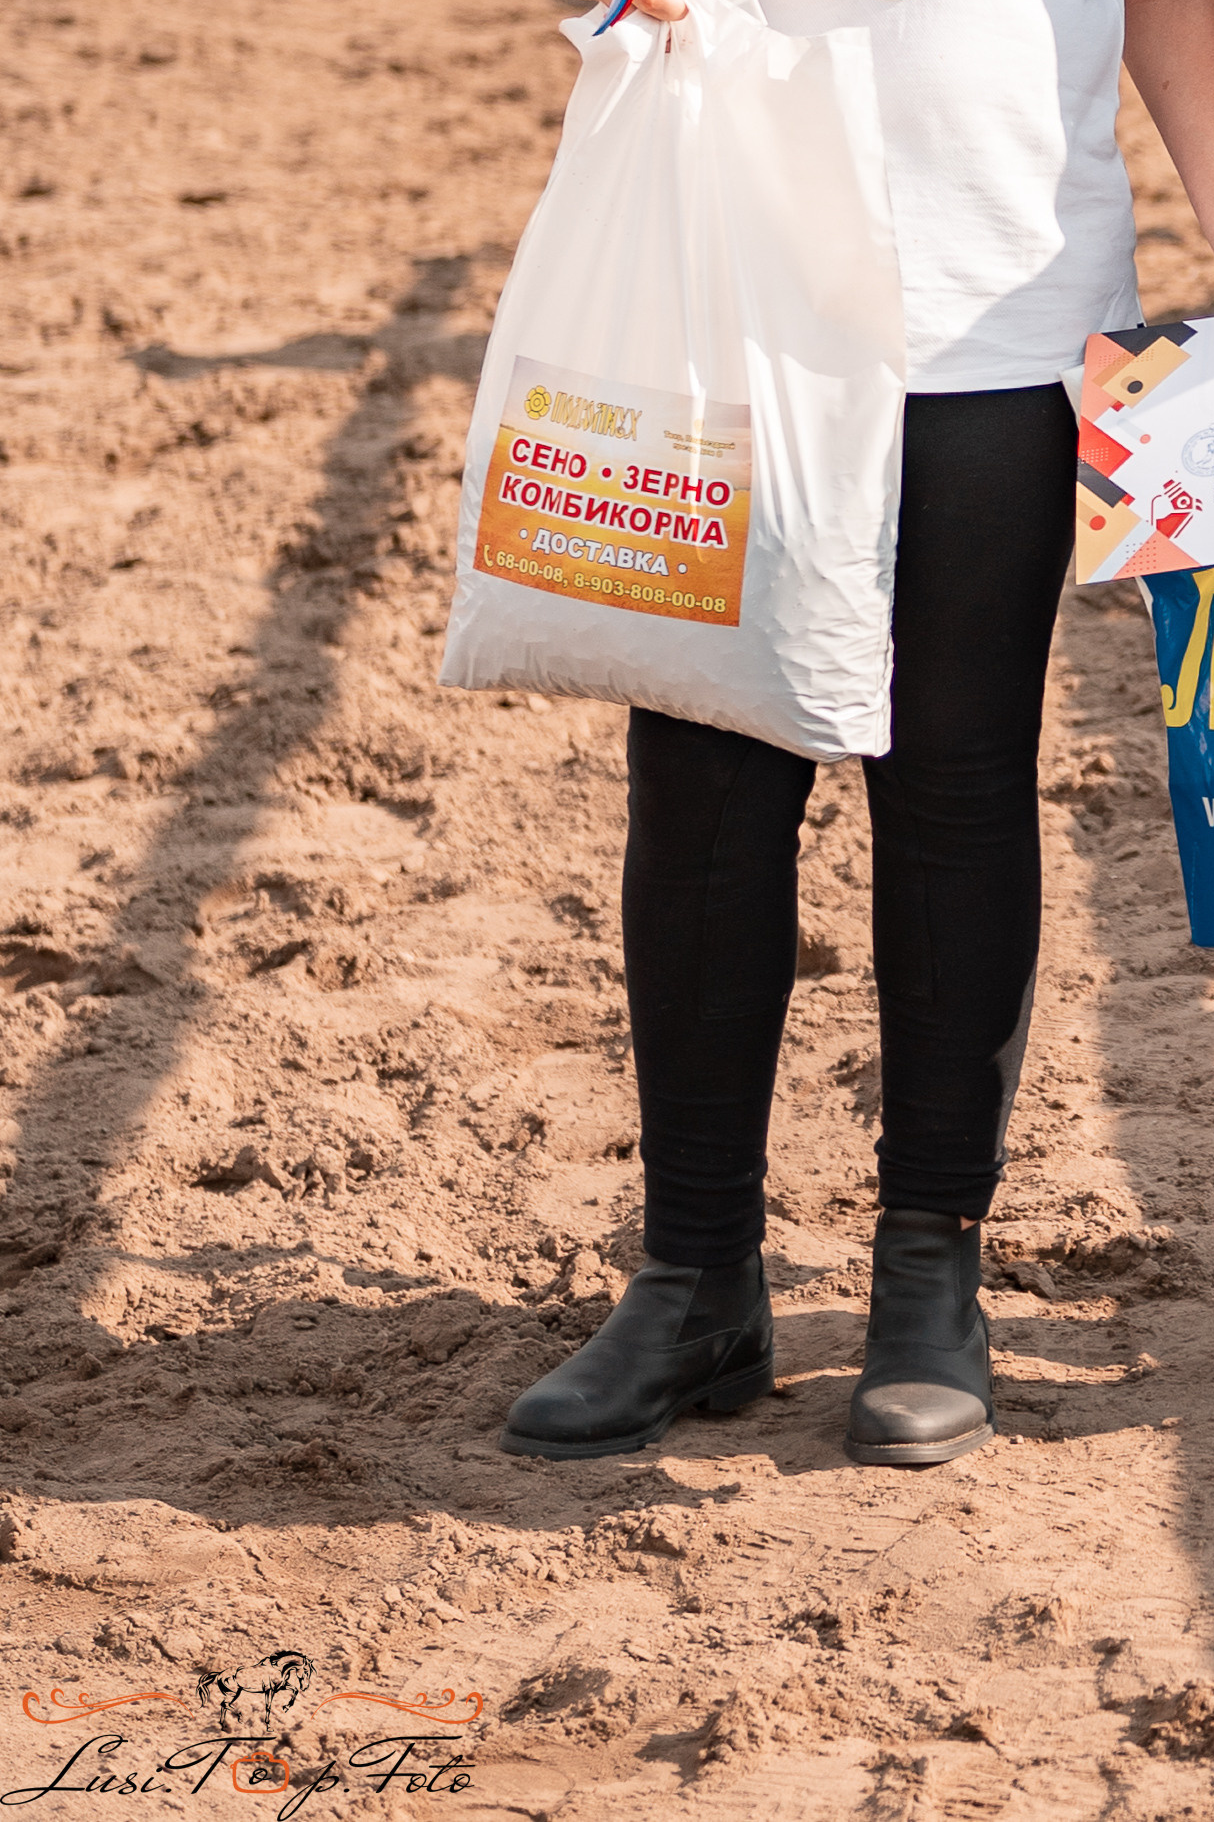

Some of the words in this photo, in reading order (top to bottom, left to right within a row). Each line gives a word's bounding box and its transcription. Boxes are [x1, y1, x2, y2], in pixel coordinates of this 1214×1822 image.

[512, 438, 587, 479] СЕНО
[623, 465, 731, 506] ЗЕРНО
[501, 475, 725, 546] КОМБИКОРМА
[496, 551, 568, 588] 68-00-08,
[573, 572, 727, 613] 8-903-808-00-08
[532, 528, 669, 576] ДОСТАВКА
